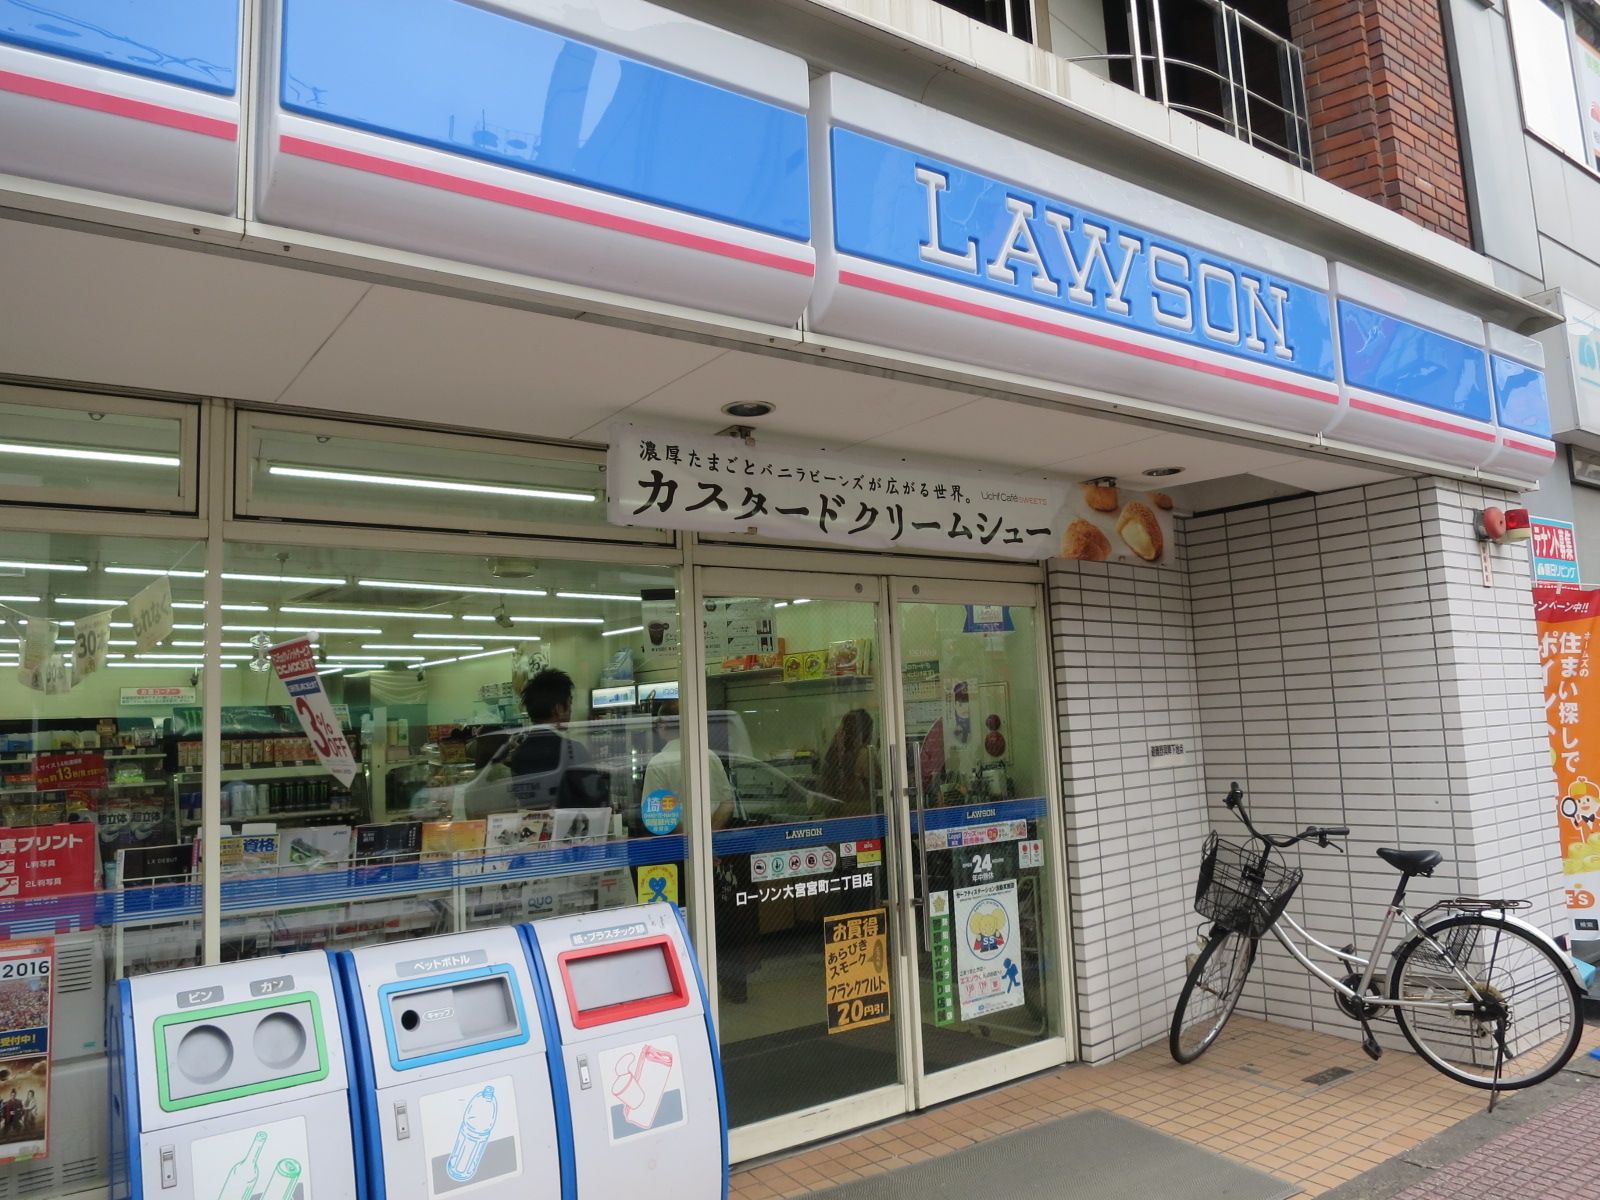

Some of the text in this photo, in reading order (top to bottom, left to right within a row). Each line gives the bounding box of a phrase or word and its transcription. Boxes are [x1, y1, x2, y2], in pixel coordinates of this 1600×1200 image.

[914, 162, 1295, 362] LAWSON
[638, 439, 972, 505] 濃厚たまごとバニラビーンズが広がる世界。
[632, 468, 1052, 546] カスタードクリームシュー
[1535, 600, 1590, 614] ンペーン中!!
[1579, 632, 1591, 678] ホームズの
[1558, 631, 1582, 774] 住まい探しで
[327, 736, 348, 758] OFF
[966, 808, 997, 820] LAWSON
[785, 827, 823, 840] LAWSON
[243, 837, 275, 852] 資格
[972, 853, 993, 874] 24
[735, 872, 874, 907] ローソン大宮宮町二丁目店
[527, 895, 553, 909] QUO
[572, 924, 646, 945] 紙・プラスチック類
[832, 916, 879, 943] お買得
[982, 935, 995, 946] SS
[828, 939, 867, 965] あらびき
[2, 960, 50, 979] 2016
[413, 956, 471, 971] ペットボトル
[830, 953, 866, 980] スモーク
[260, 979, 285, 993] カン
[828, 975, 886, 1001] フランクフルト
[188, 991, 213, 1004] ビン
[425, 1007, 452, 1020] キャップ
[837, 999, 884, 1026] 20円引
